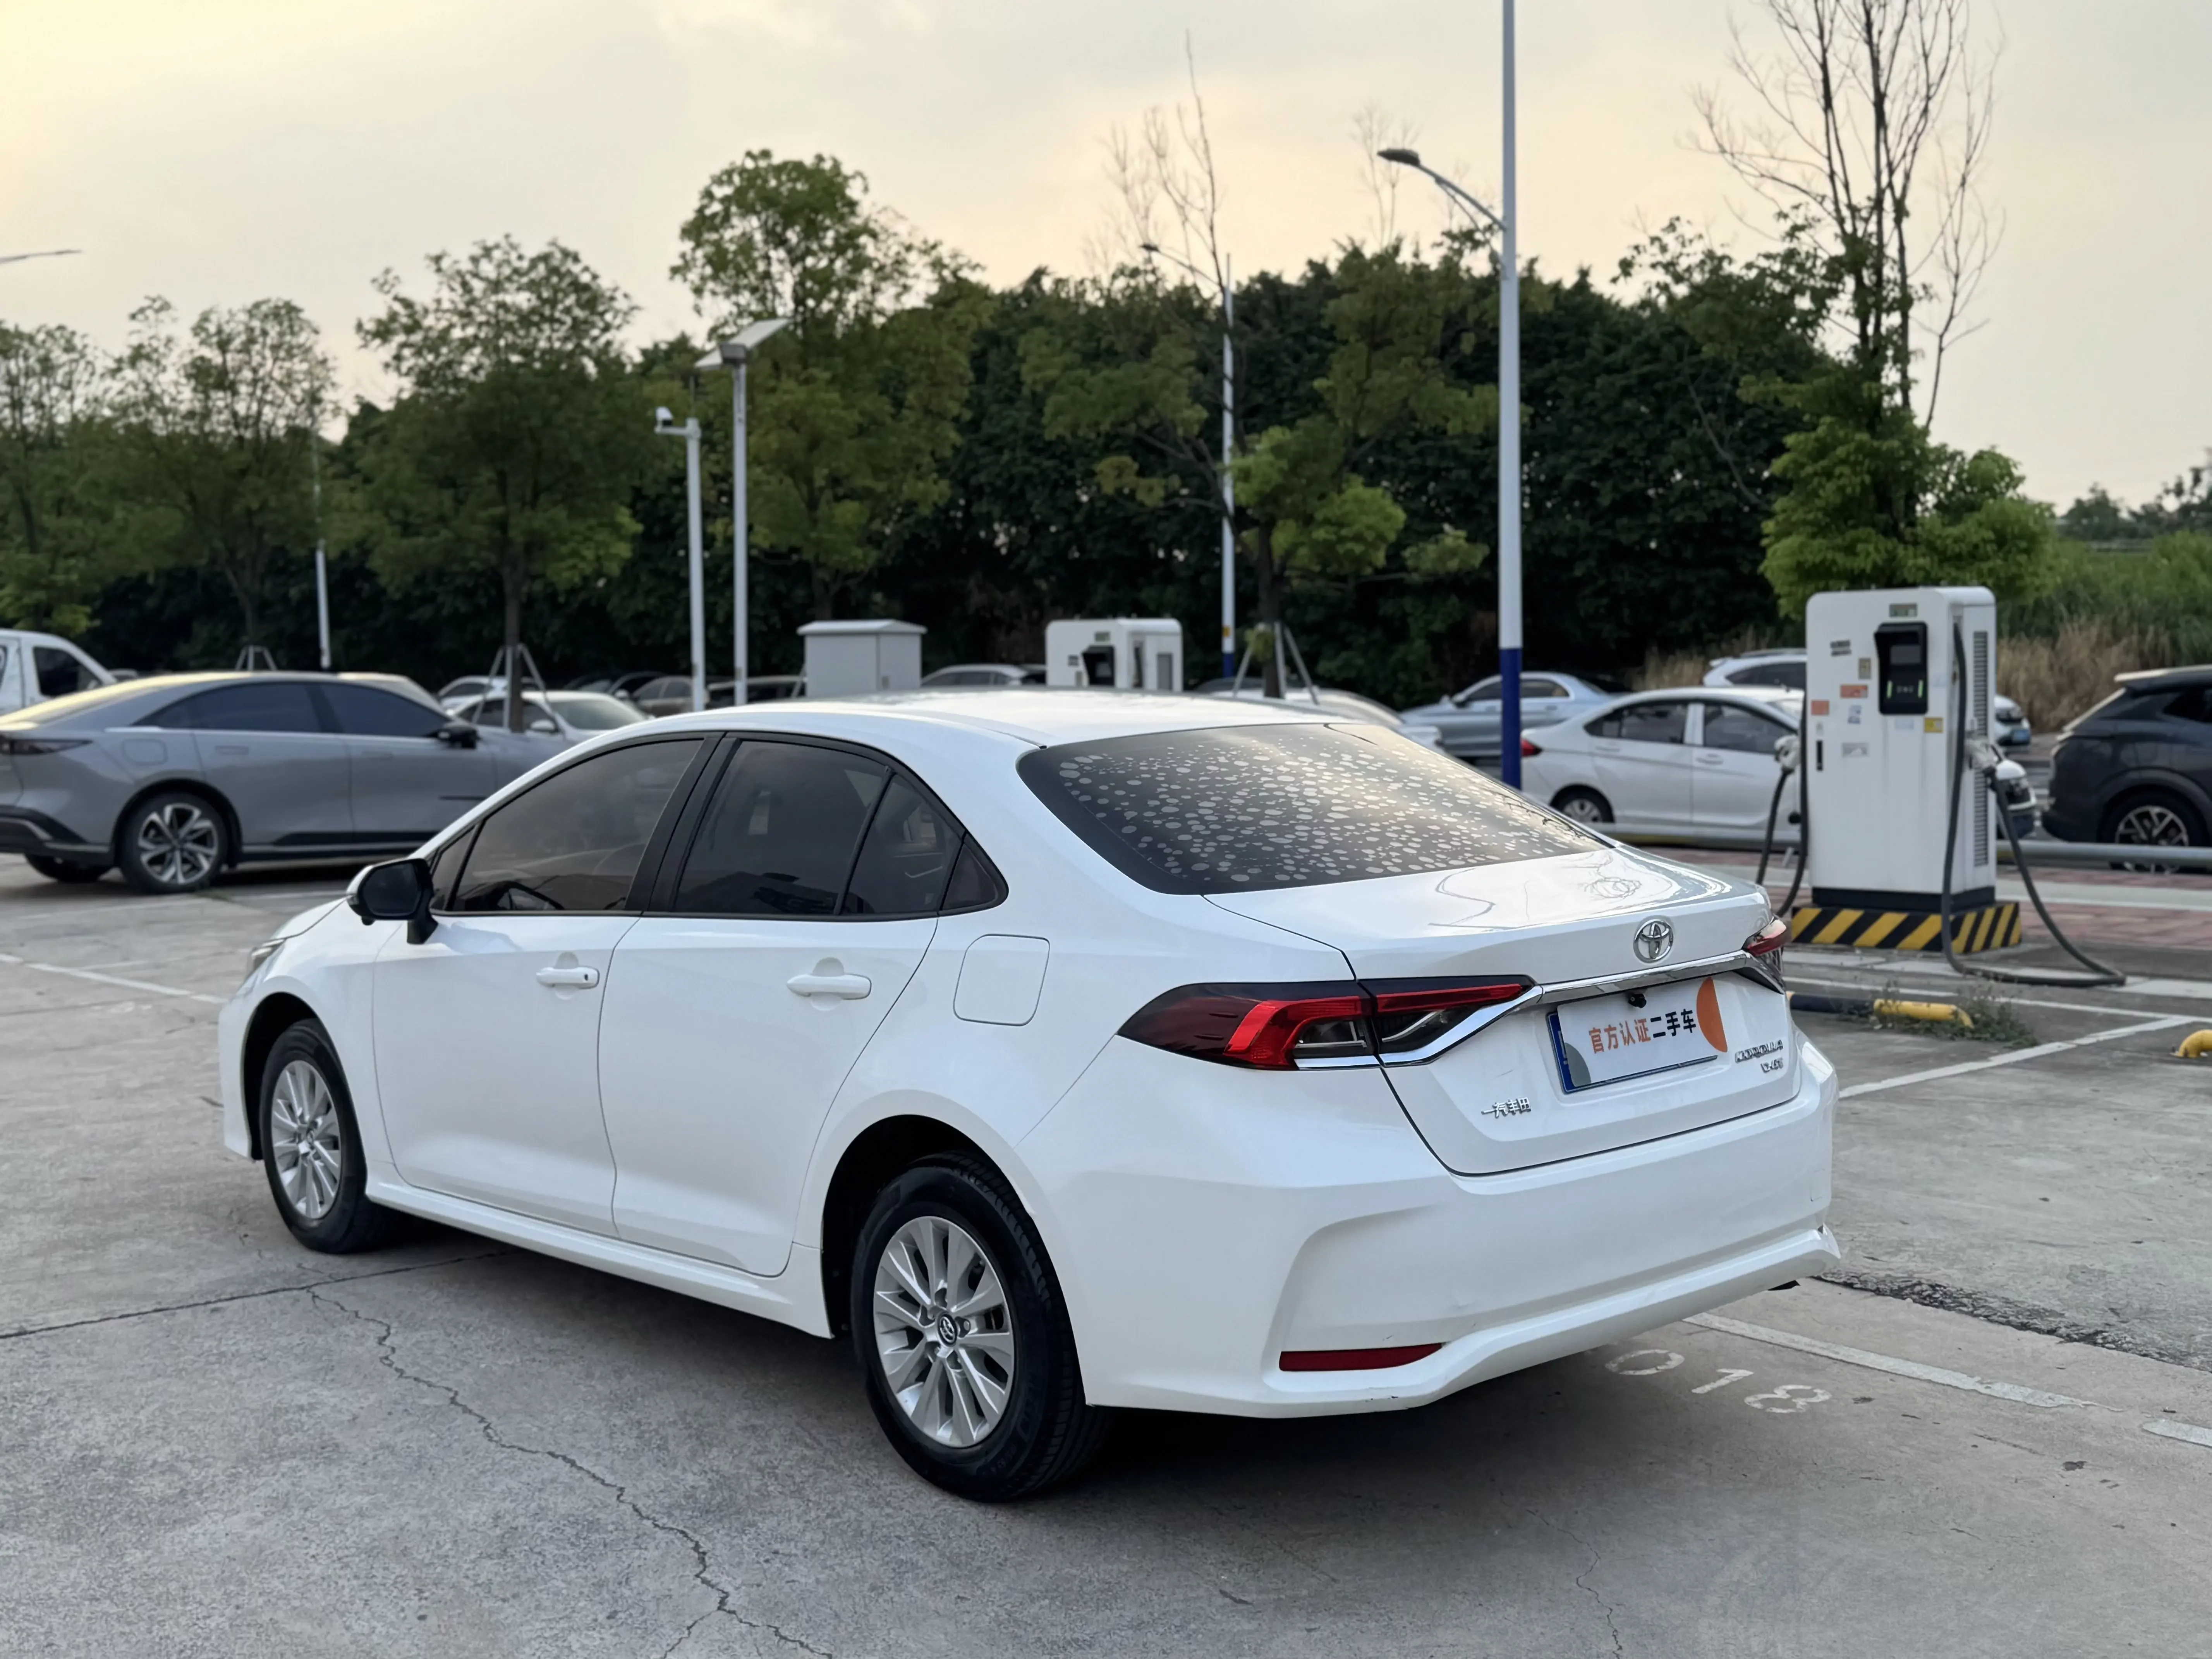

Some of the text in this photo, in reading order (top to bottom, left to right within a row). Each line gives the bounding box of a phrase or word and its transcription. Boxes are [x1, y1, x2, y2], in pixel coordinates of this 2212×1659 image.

[1589, 1008, 1696, 1054] 官方认证二手车
[1735, 1039, 1783, 1064] COROLLA
[1481, 1097, 1531, 1119] 一汽丰田
[1604, 1349, 1832, 1413] 018
